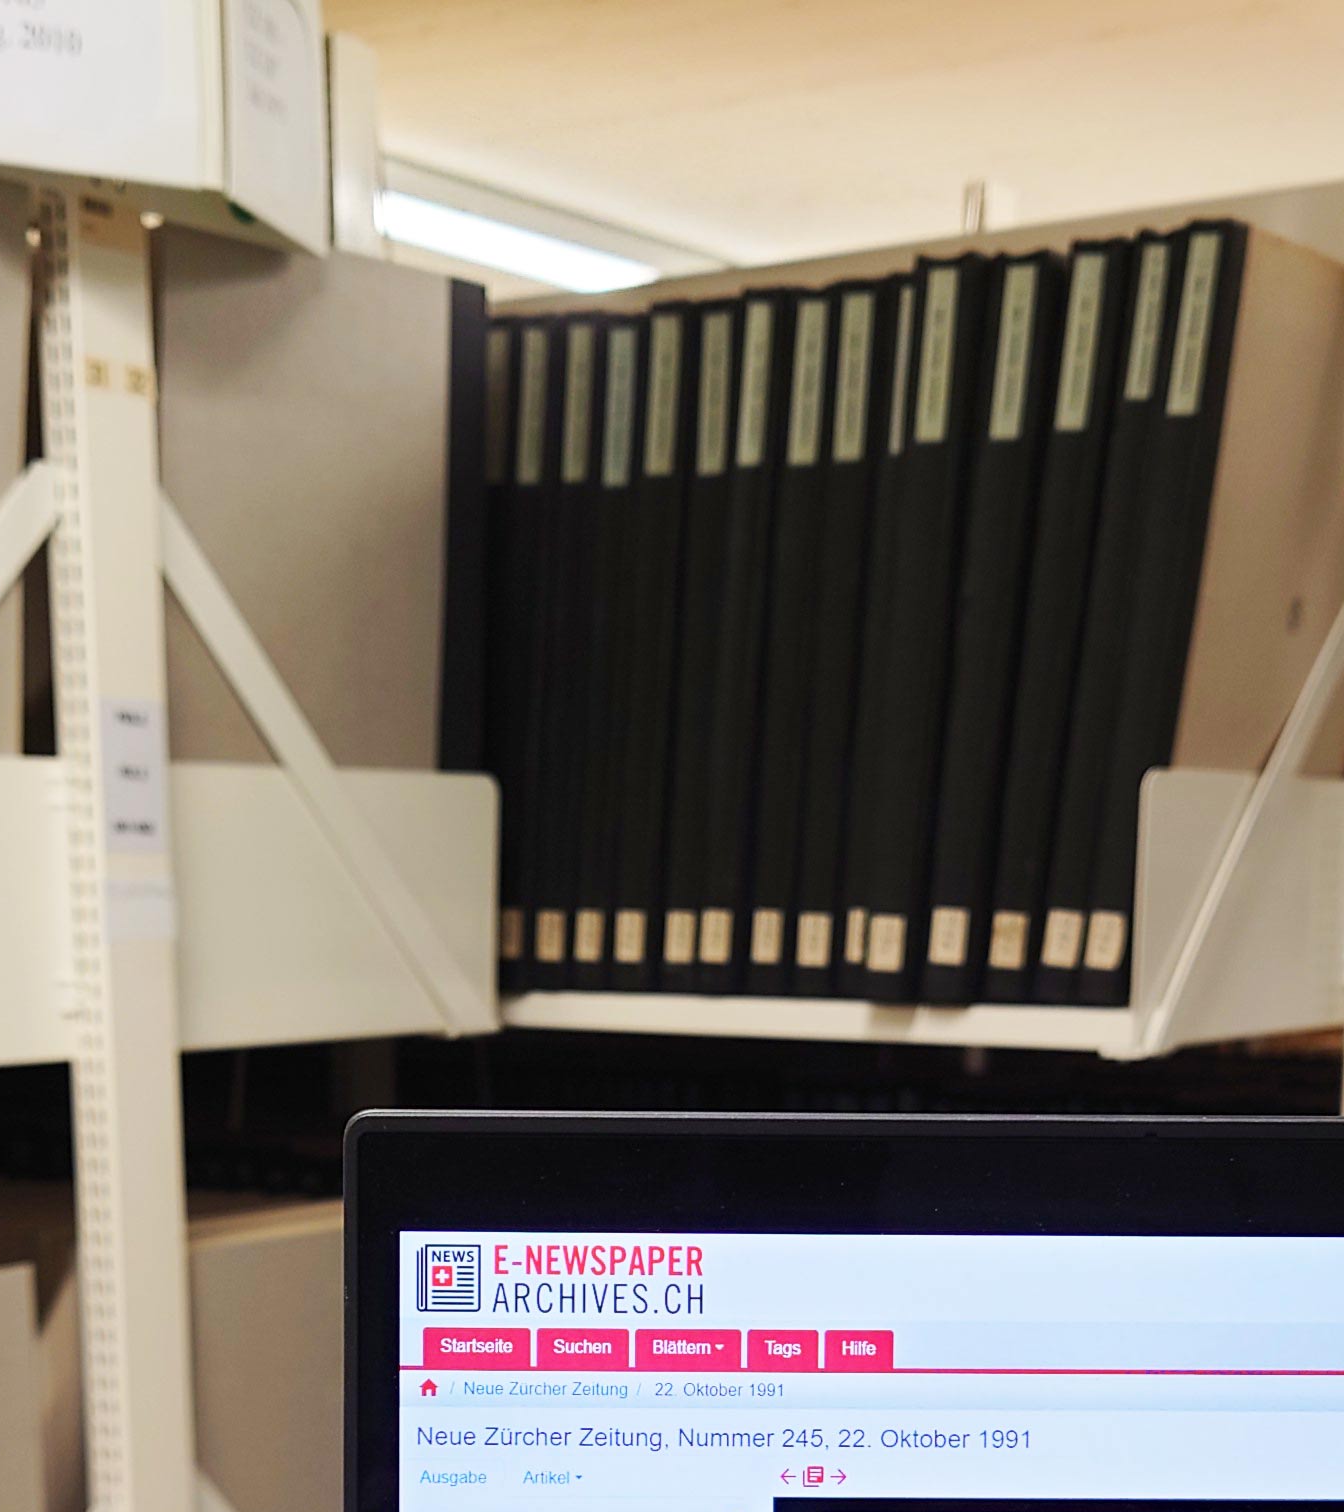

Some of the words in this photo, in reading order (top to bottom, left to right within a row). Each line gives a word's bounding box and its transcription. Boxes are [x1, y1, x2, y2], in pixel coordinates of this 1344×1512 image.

[432, 1251, 474, 1262] NEWS
[495, 1245, 702, 1276] E-NEWSPAPER
[493, 1283, 703, 1314] ARCHIVES.CH
[440, 1338, 513, 1353] Startseite
[554, 1338, 611, 1354] Suchen
[653, 1340, 711, 1354] Blättern
[764, 1340, 801, 1358] Tags
[842, 1341, 876, 1355] Hilfe
[464, 1382, 503, 1395] Neue
[509, 1382, 566, 1395] Zürcher
[572, 1382, 627, 1399] Zeitung
[655, 1383, 677, 1396] 22.
[684, 1383, 742, 1396] Oktober
[750, 1383, 782, 1396] 1991
[418, 1427, 476, 1445] Neue
[484, 1427, 571, 1446] Zürcher
[579, 1428, 668, 1451] Zeitung,
[679, 1428, 774, 1447] Nummer
[783, 1429, 828, 1449] 245,
[838, 1429, 871, 1447] 22.
[881, 1430, 970, 1448] Oktober
[980, 1430, 1029, 1448] 1991
[420, 1470, 486, 1486] Ausgabe
[523, 1471, 569, 1484] Artikel
